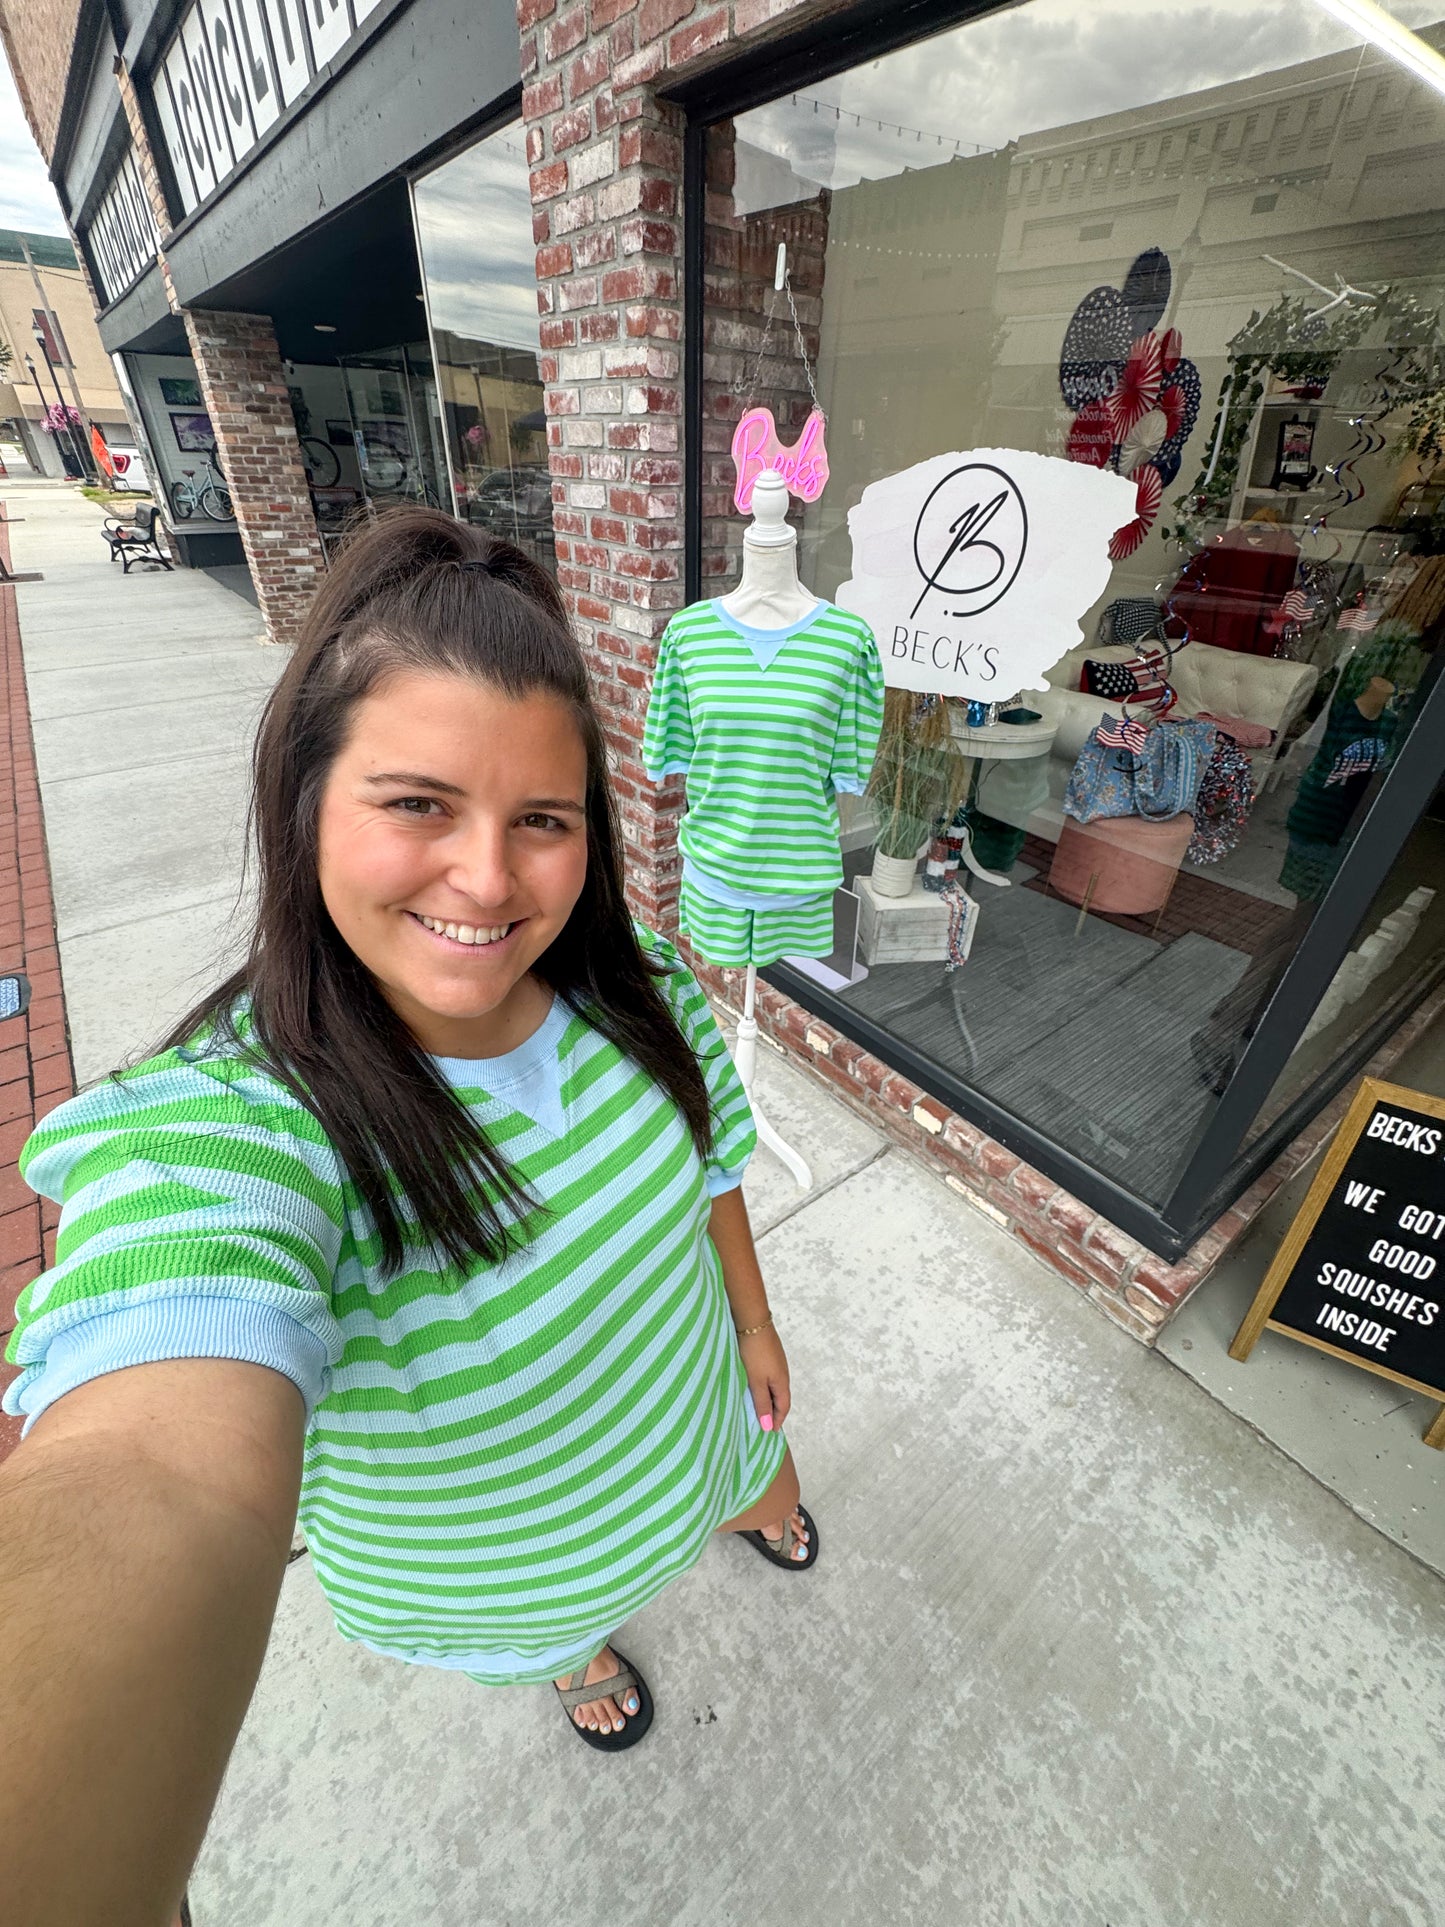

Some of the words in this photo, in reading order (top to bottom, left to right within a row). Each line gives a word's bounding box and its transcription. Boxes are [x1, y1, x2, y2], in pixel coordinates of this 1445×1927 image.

[179, 0, 339, 171] CYCLI
[733, 413, 825, 512] Becks
[891, 625, 1000, 682] BECK'S
[1366, 1112, 1442, 1155] BECKS
[1344, 1180, 1386, 1214] WE
[1398, 1204, 1445, 1240] GOT
[1368, 1239, 1437, 1280] GOOD
[1317, 1262, 1440, 1326] SQUISHES
[1315, 1303, 1397, 1352] INSIDE
